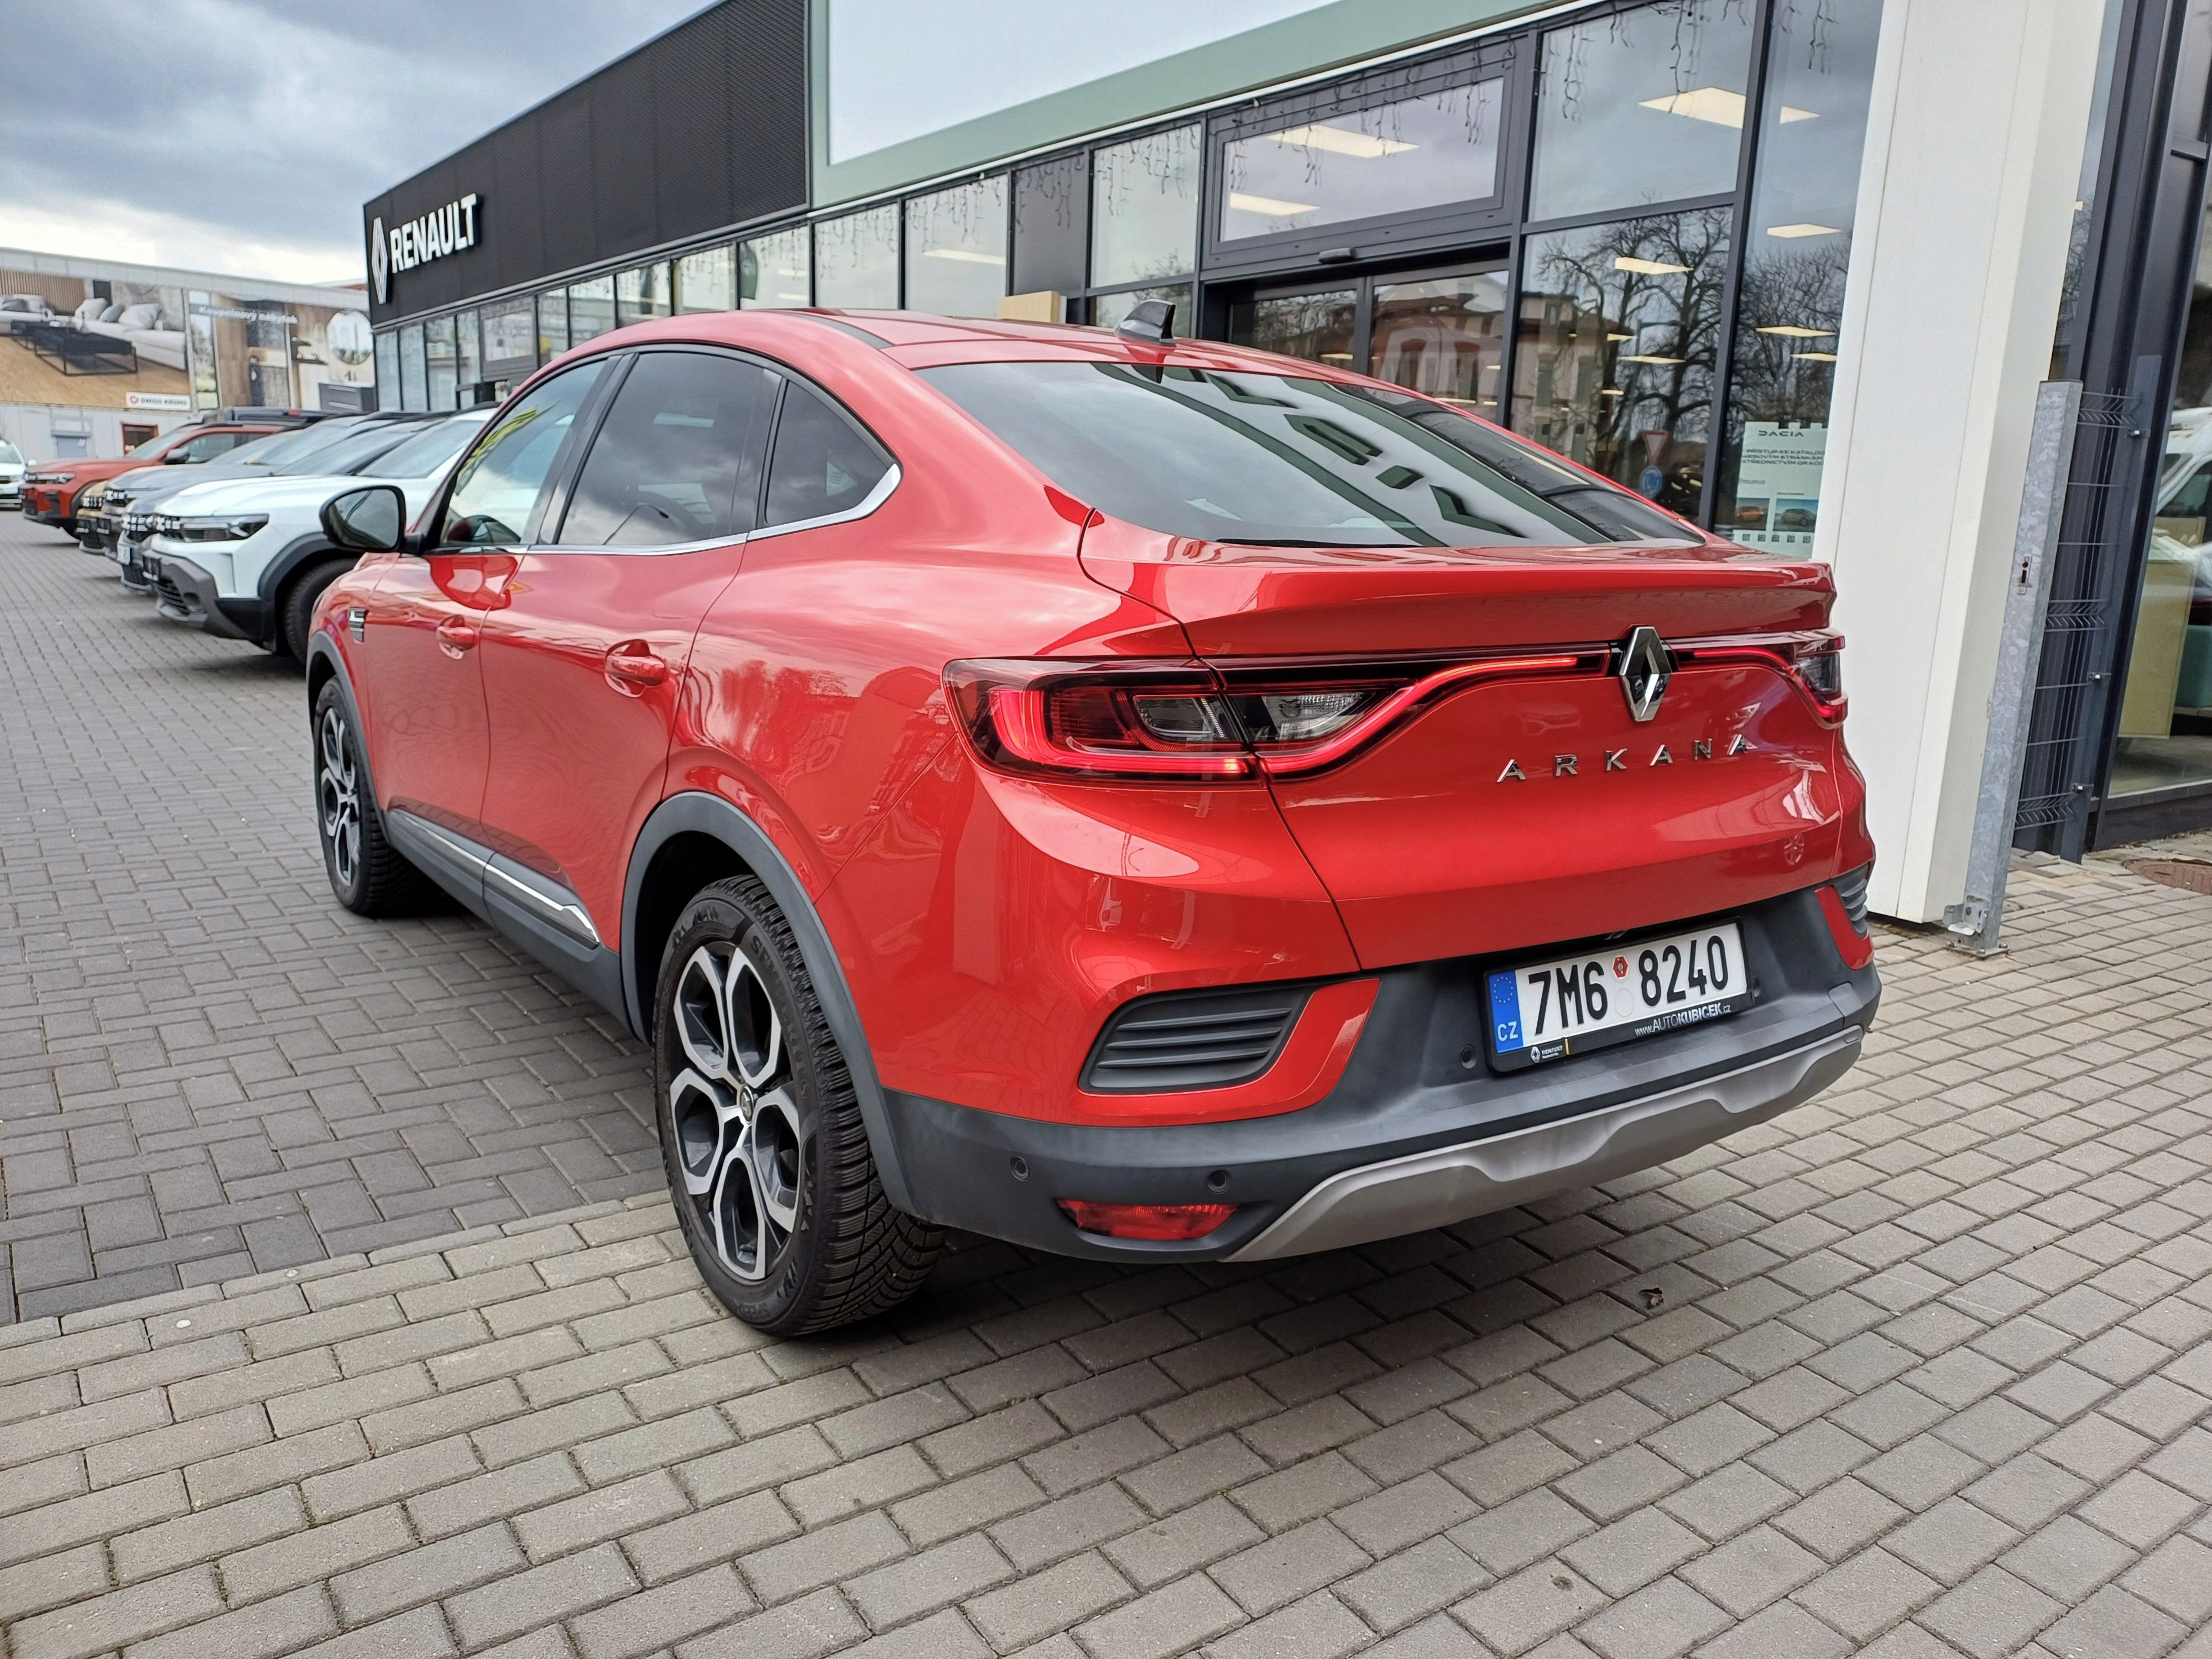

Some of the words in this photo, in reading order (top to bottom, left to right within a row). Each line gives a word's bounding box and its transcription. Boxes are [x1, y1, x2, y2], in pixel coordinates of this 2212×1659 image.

[390, 193, 476, 273] RENAULT
[1496, 734, 1751, 782] ARKANA
[1528, 961, 1608, 1036] 7M6
[1638, 935, 1729, 1006] 8240
[1498, 1021, 1519, 1042] CZ
[1634, 1003, 1731, 1036] www.AUTOKUBICEK.cz
